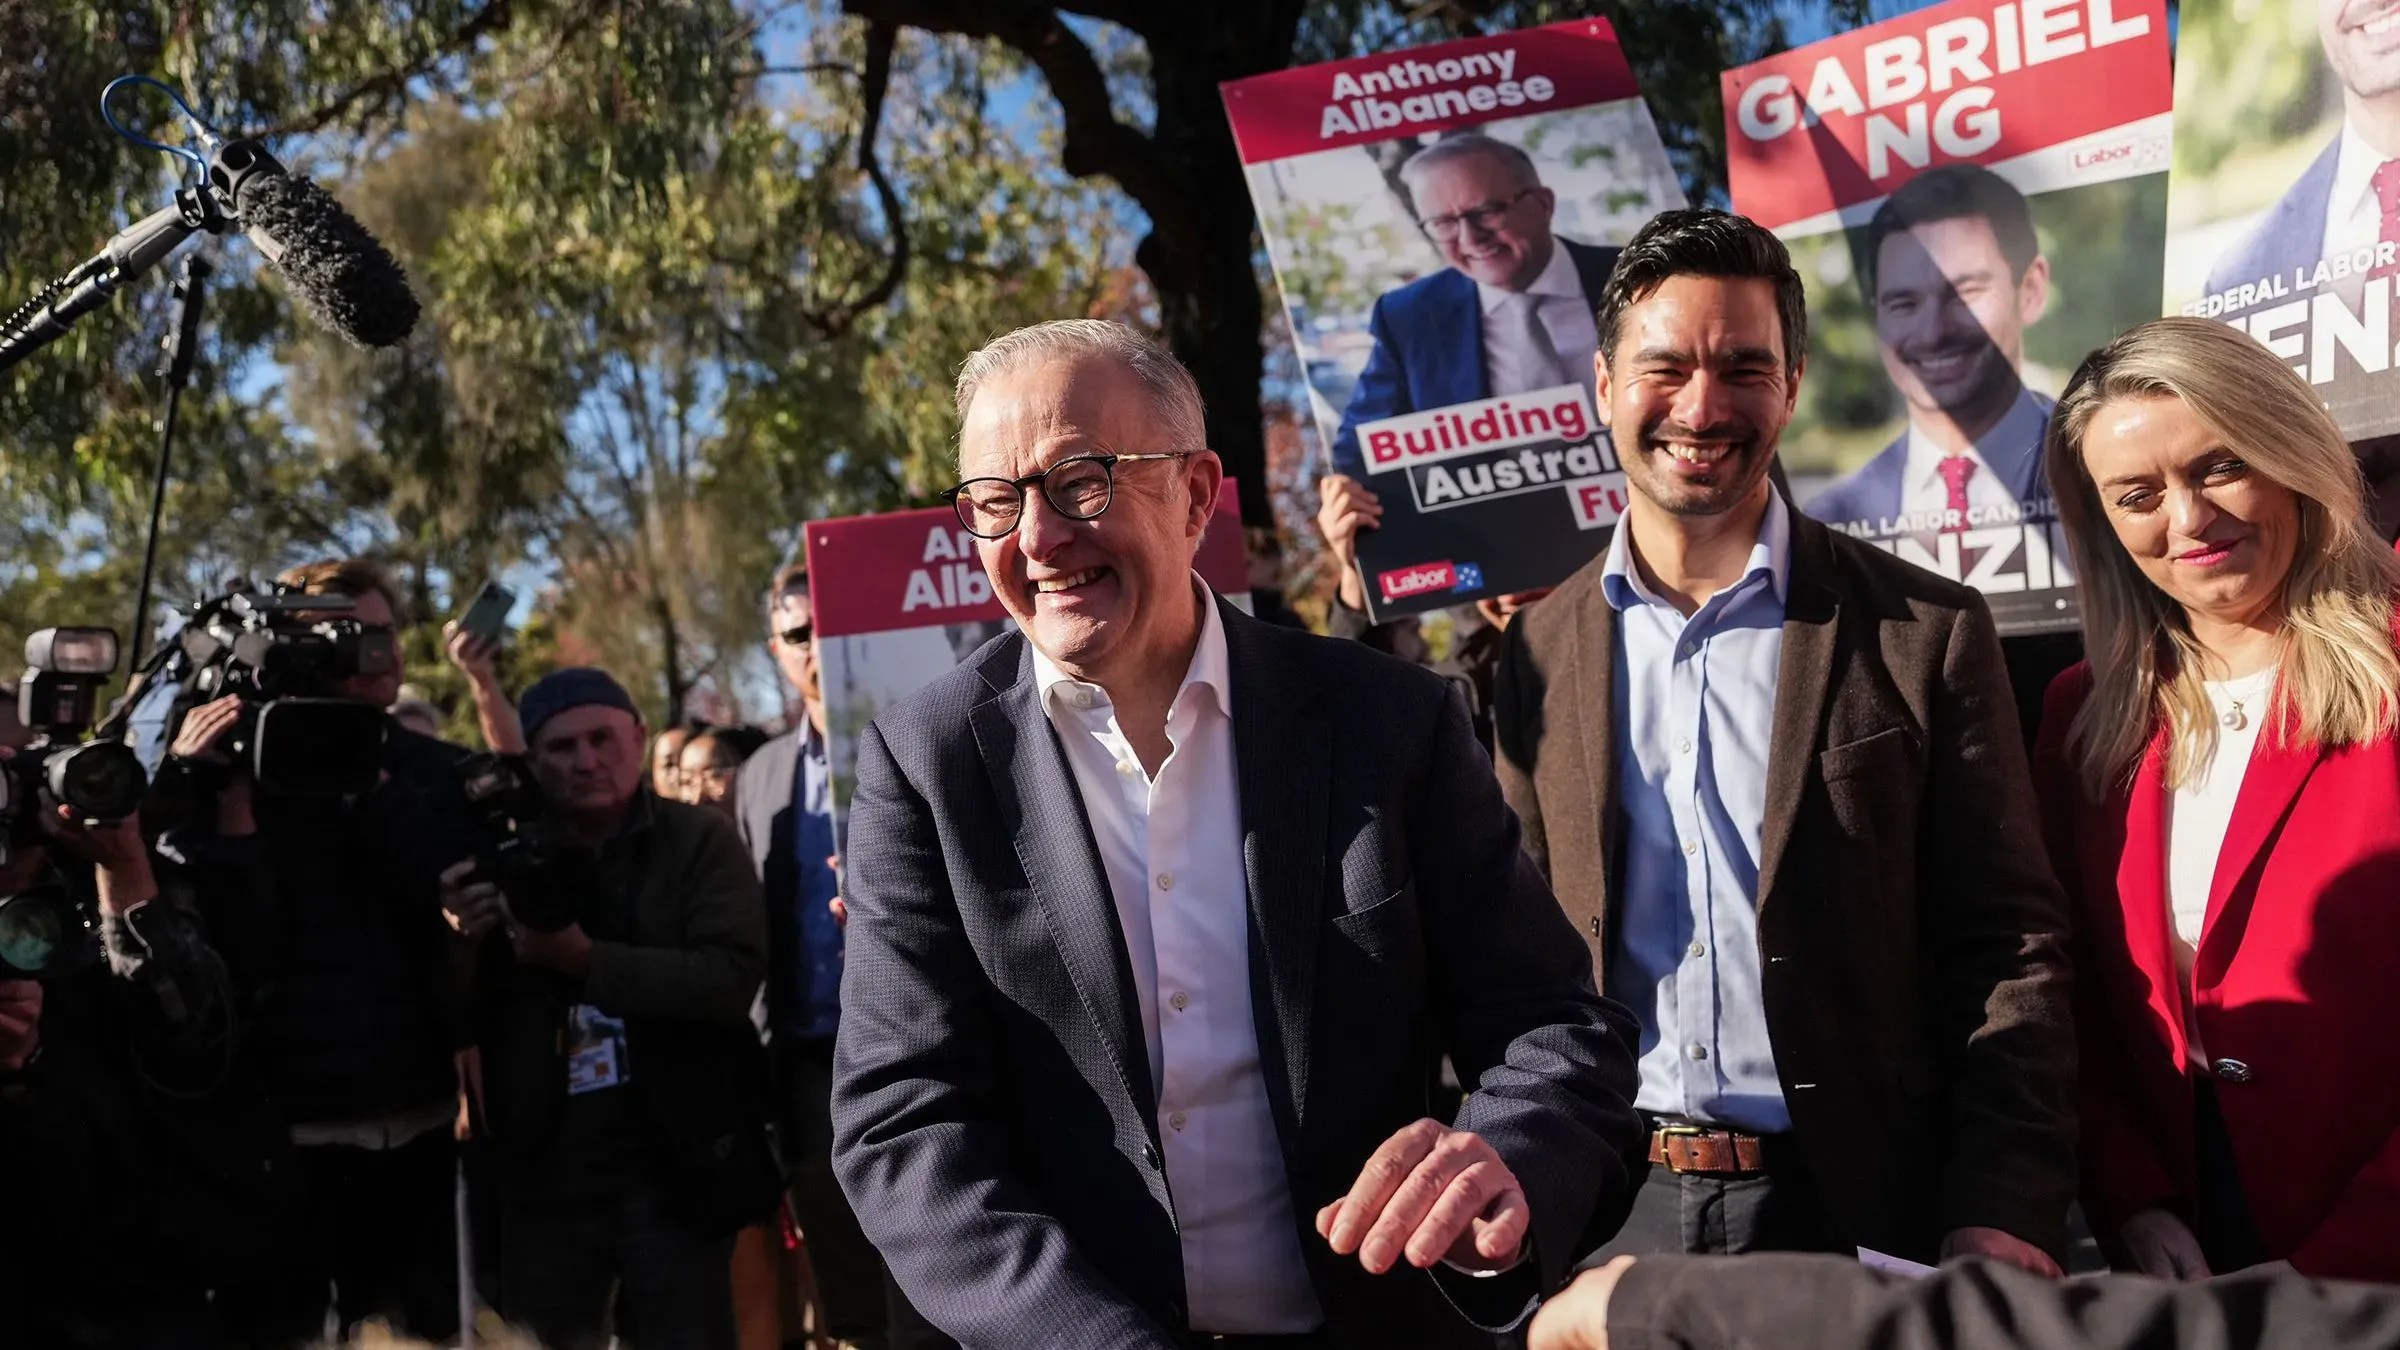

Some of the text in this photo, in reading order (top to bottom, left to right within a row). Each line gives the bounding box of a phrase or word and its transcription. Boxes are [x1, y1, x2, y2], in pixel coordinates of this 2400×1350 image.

[1332, 48, 1516, 101] Anthony
[1737, 0, 2150, 142] GABRIEL
[1320, 75, 1556, 139] Albanese
[1864, 86, 2002, 180] NG
[2075, 144, 2133, 168] Labor
[2180, 240, 2397, 319] FEDERAL LABOR
[2226, 276, 2400, 386] EN
[1368, 400, 1587, 465] Building
[1880, 508, 1963, 533] LABOR
[1386, 568, 1448, 595] Labor
[1871, 522, 2077, 594] NZI
